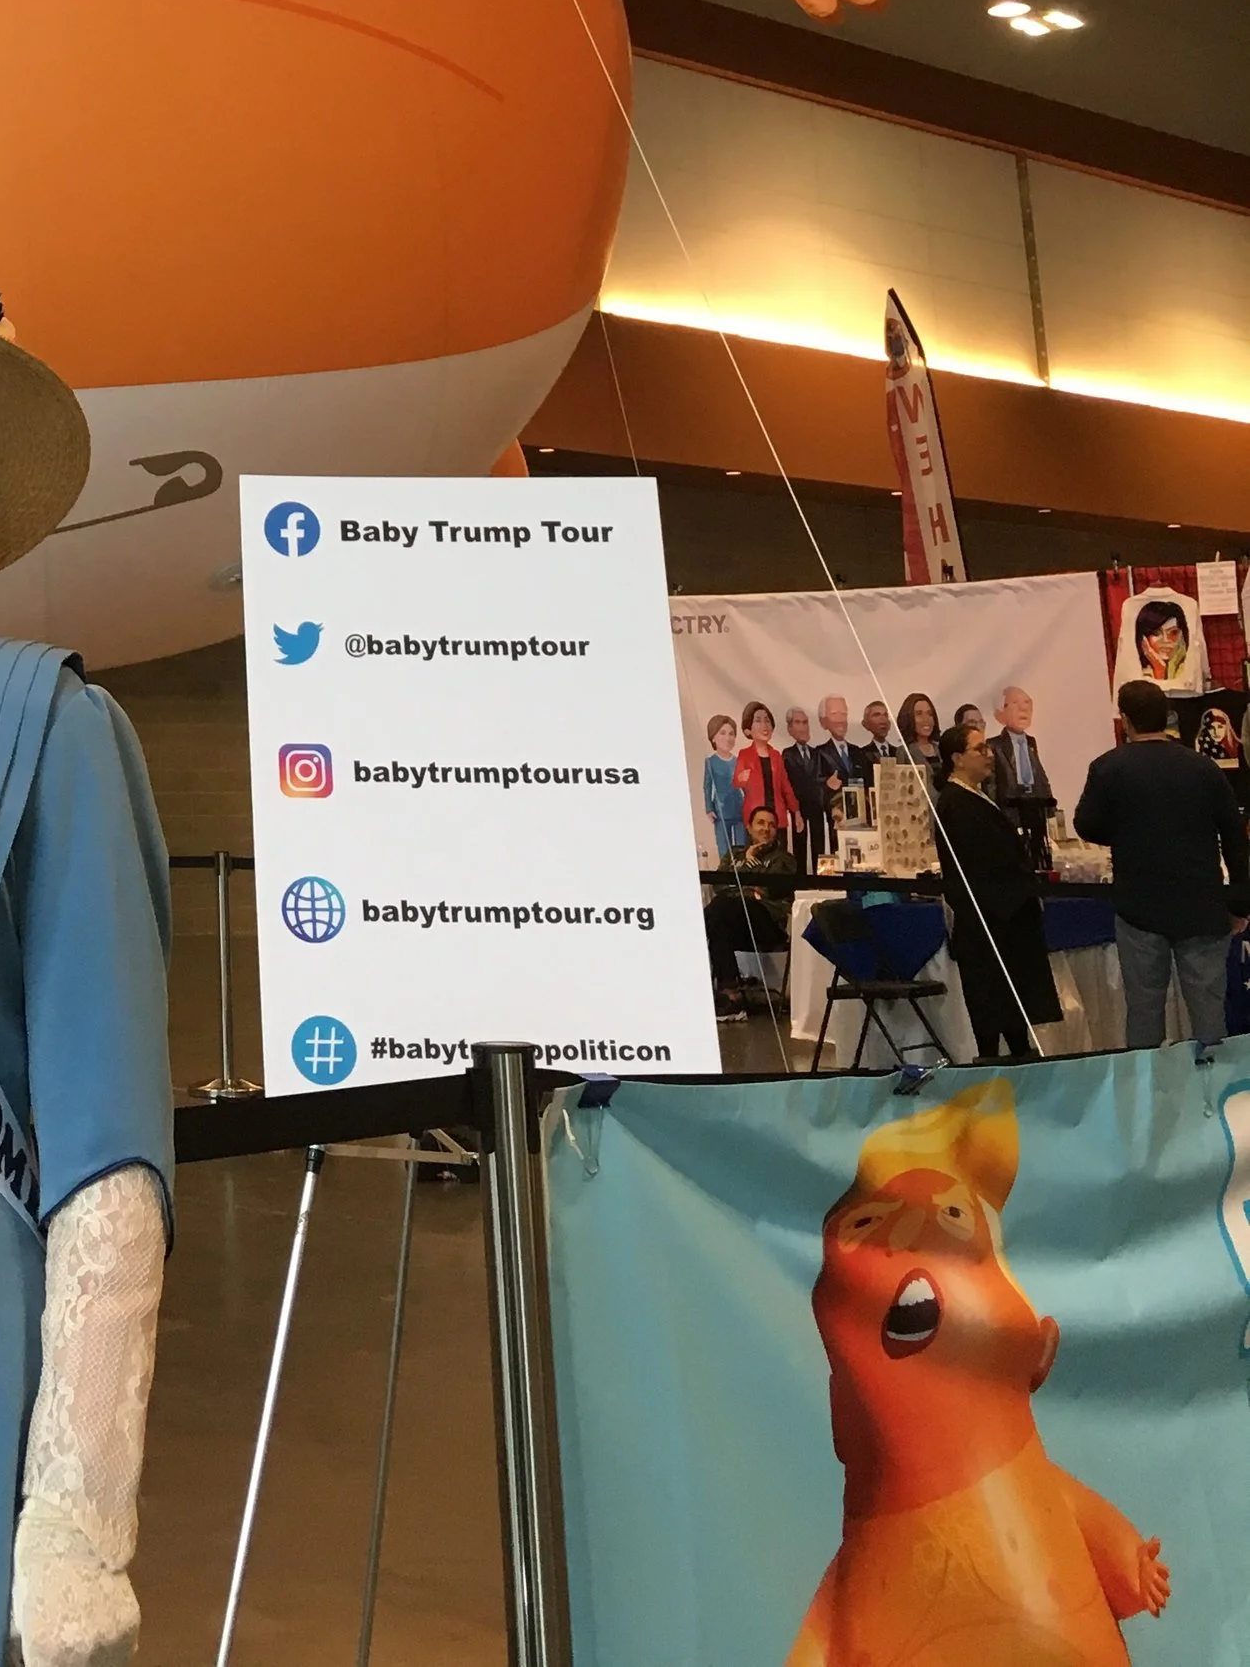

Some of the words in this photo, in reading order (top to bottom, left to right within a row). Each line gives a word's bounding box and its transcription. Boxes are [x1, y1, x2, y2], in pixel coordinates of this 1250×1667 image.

[340, 520, 419, 548] Baby
[428, 520, 531, 549] Trump
[540, 520, 614, 544] Tour
[344, 633, 590, 662] @babytrumptour
[353, 760, 640, 789] babytrumptourusa
[362, 899, 655, 931] babytrumptour.org
[370, 1037, 671, 1068] #babytppoliticon
